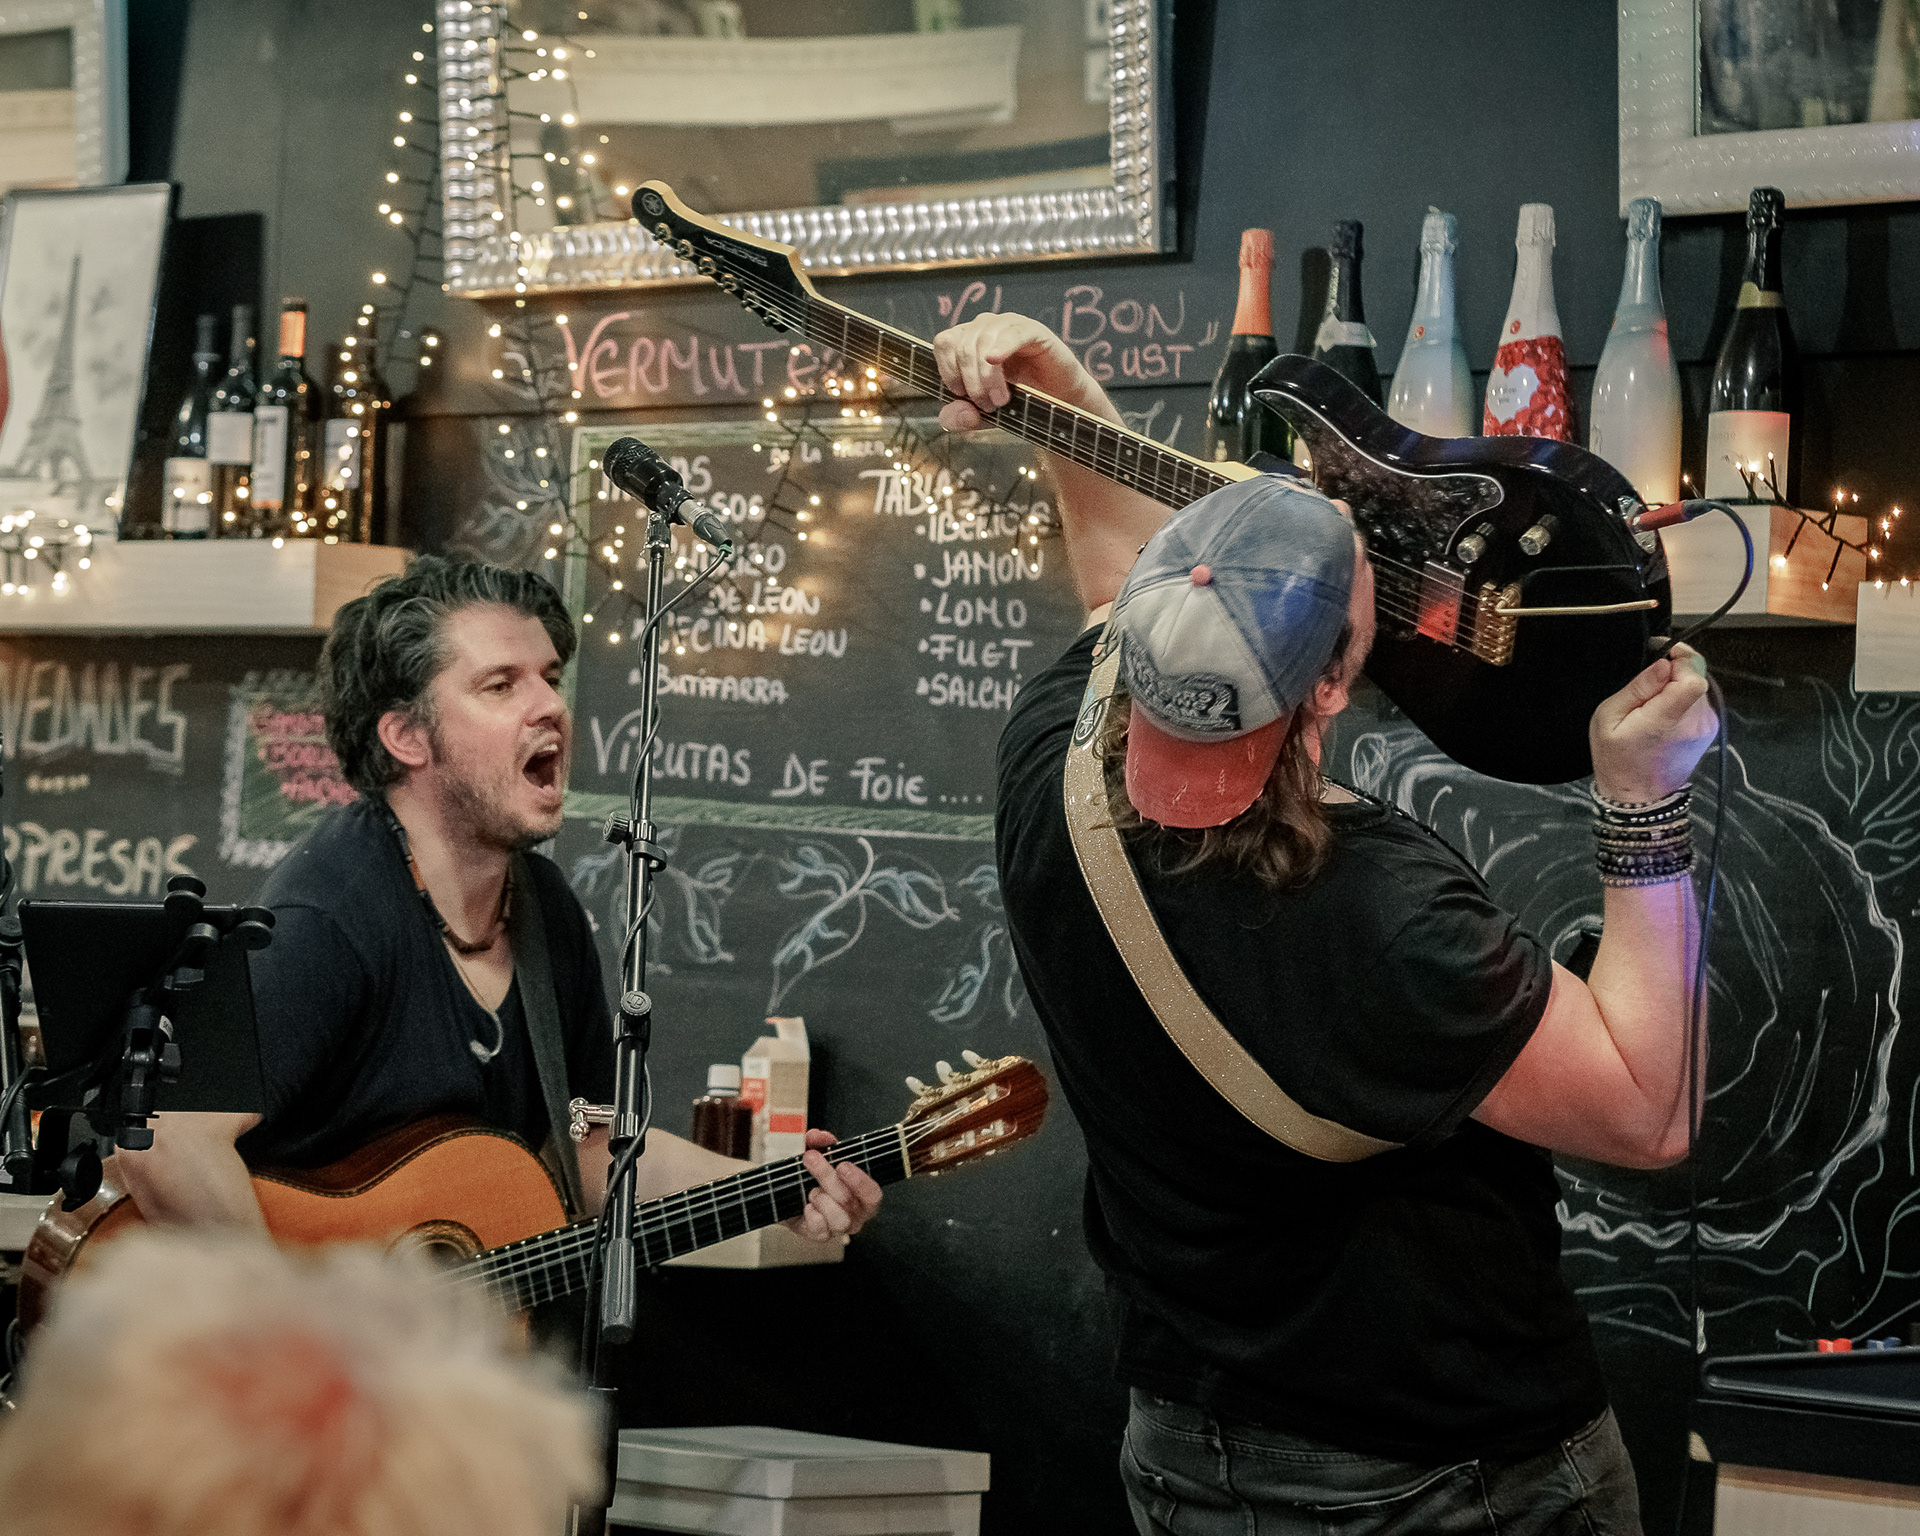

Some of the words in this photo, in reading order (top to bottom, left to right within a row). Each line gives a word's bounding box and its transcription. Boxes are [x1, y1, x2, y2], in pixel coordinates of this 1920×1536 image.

[1061, 285, 1186, 344] BON
[557, 311, 845, 397] VERMUTE
[931, 549, 1044, 588] JAMON
[751, 580, 821, 616] LEON
[934, 597, 1028, 629] LOMO
[779, 624, 848, 658] LEON
[929, 635, 1034, 670] FUET
[770, 753, 830, 799] DE
